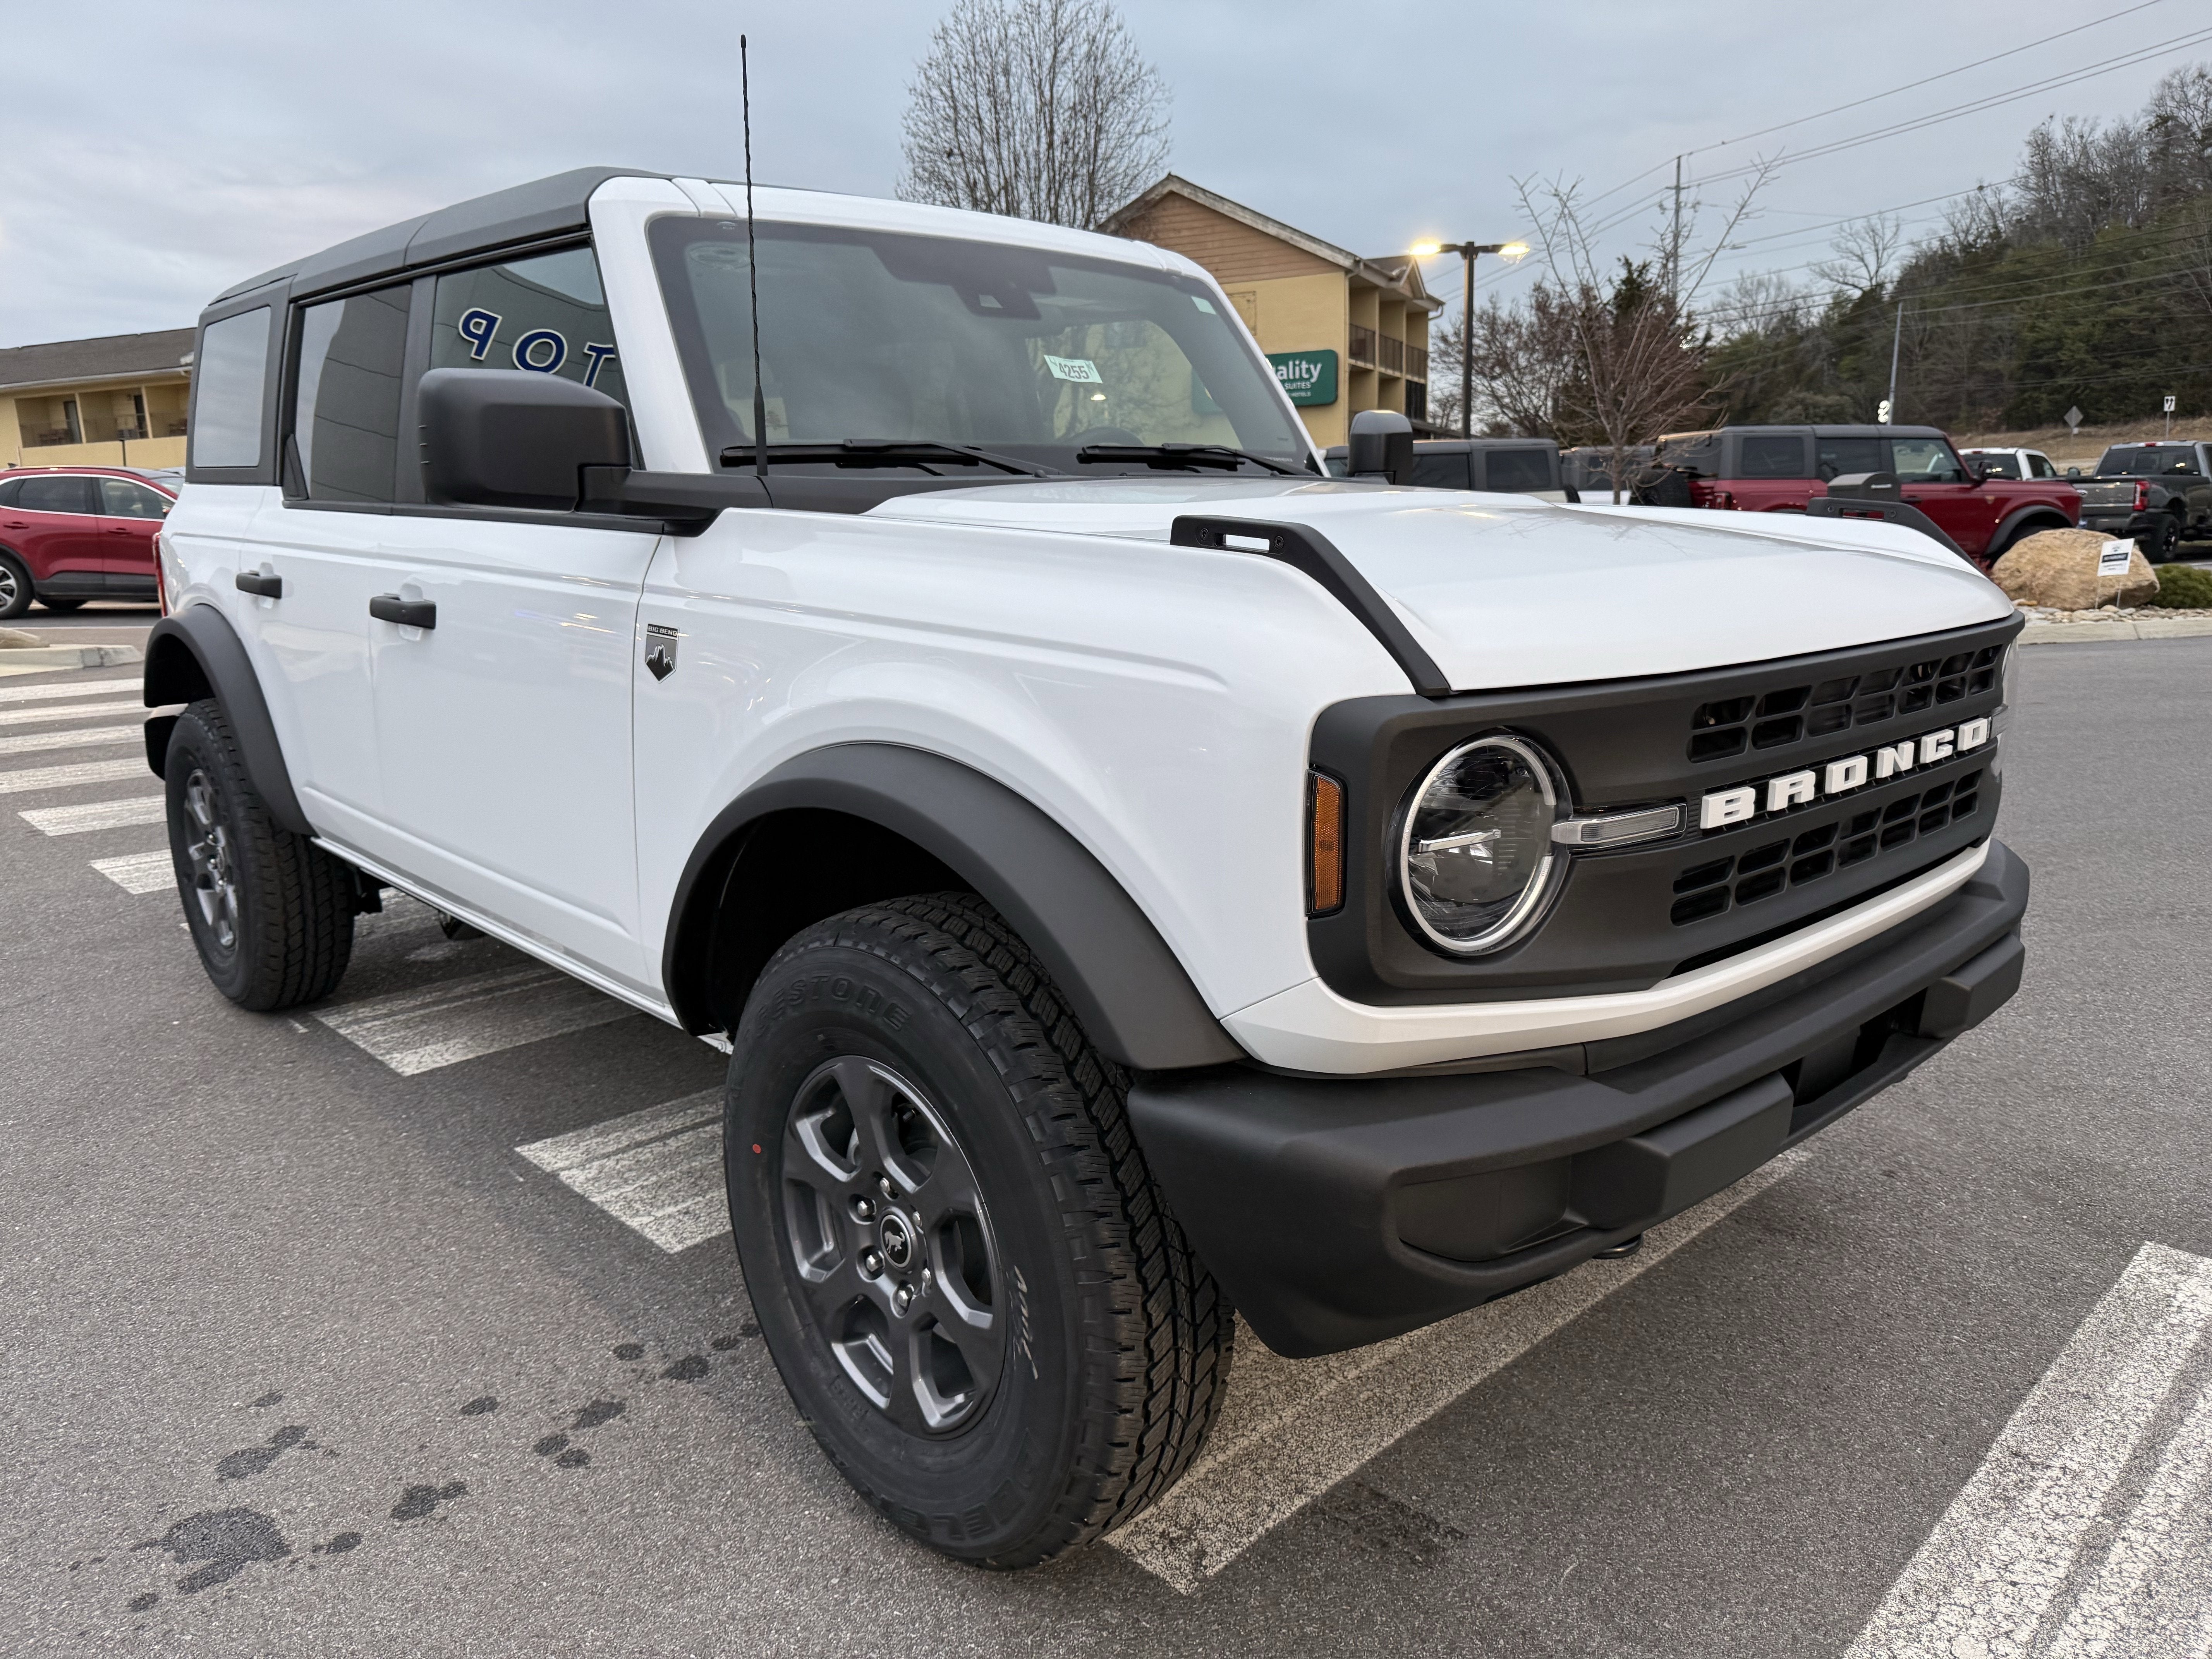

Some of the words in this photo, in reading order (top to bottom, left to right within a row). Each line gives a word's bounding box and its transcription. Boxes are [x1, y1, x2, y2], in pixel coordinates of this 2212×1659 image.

[1059, 363, 1089, 379] 4255
[1273, 359, 1322, 383] ality
[1284, 381, 1311, 390] SUITES
[659, 628, 678, 636] BEND
[1699, 717, 1989, 829] BRONCO
